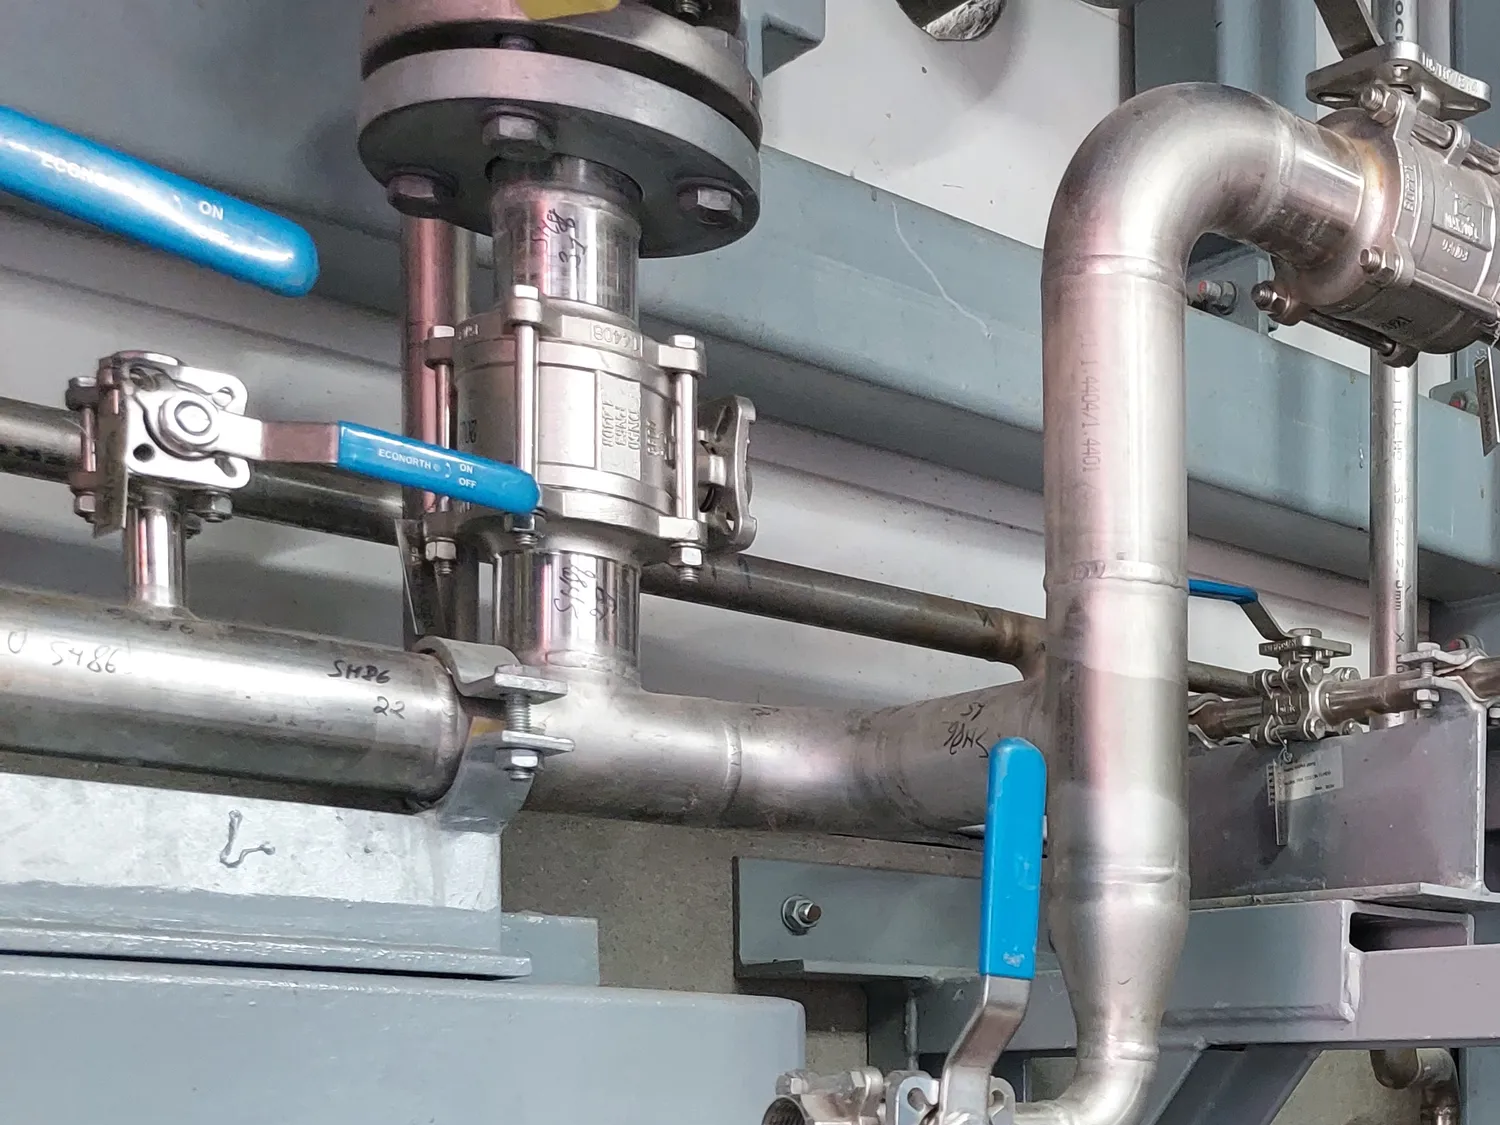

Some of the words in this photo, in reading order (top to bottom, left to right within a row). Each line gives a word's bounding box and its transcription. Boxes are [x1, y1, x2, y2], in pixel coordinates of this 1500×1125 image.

[199, 200, 224, 221] ON
[378, 448, 431, 471] ECONORTH
[459, 463, 474, 475] ON
[458, 477, 477, 489] OFF
